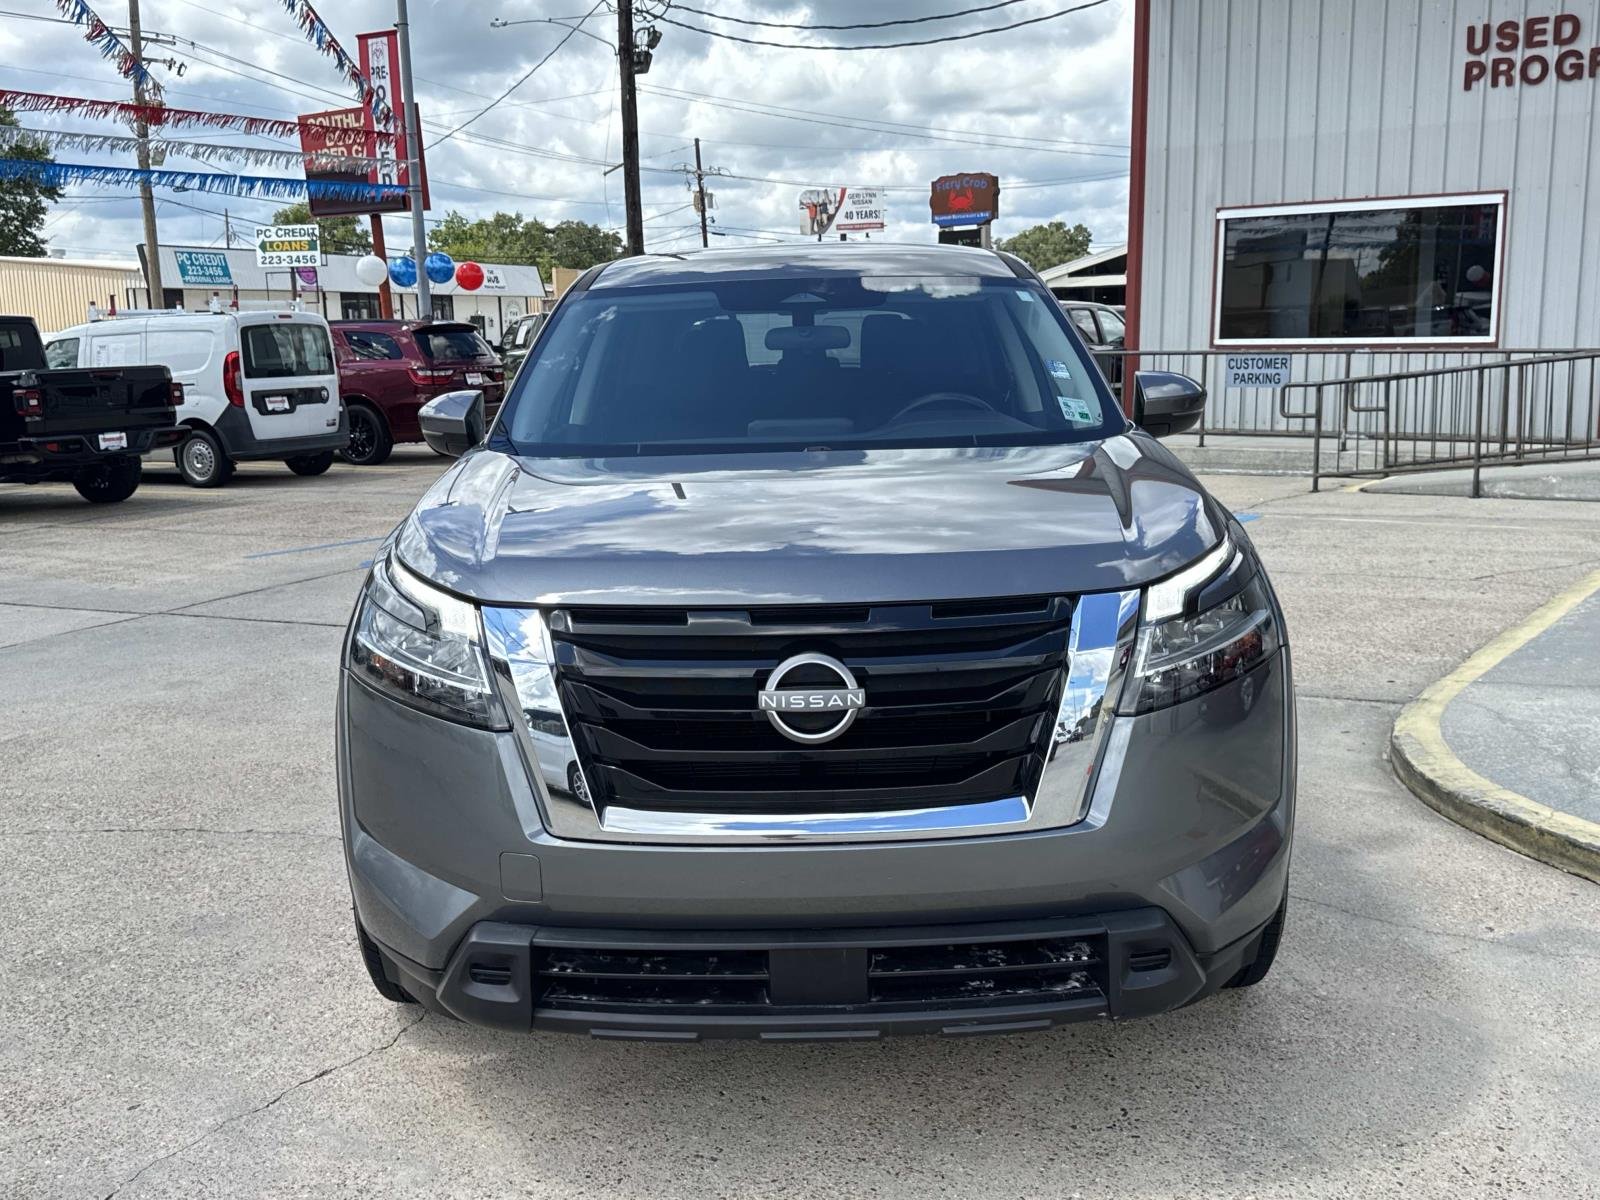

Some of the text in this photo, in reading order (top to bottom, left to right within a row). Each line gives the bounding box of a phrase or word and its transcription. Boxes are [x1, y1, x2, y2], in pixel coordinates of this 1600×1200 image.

[1466, 13, 1581, 56] USED
[844, 210, 854, 220] 40
[256, 227, 318, 239] PC CREDIT
[266, 240, 309, 251] LOANS
[176, 252, 226, 266] PC CREDIT
[261, 255, 317, 265] 223-3456
[187, 266, 223, 275] 223-3456
[1228, 357, 1288, 370] CUSTOMER
[1233, 372, 1281, 385] PARKING
[761, 692, 863, 708] NISSAN
